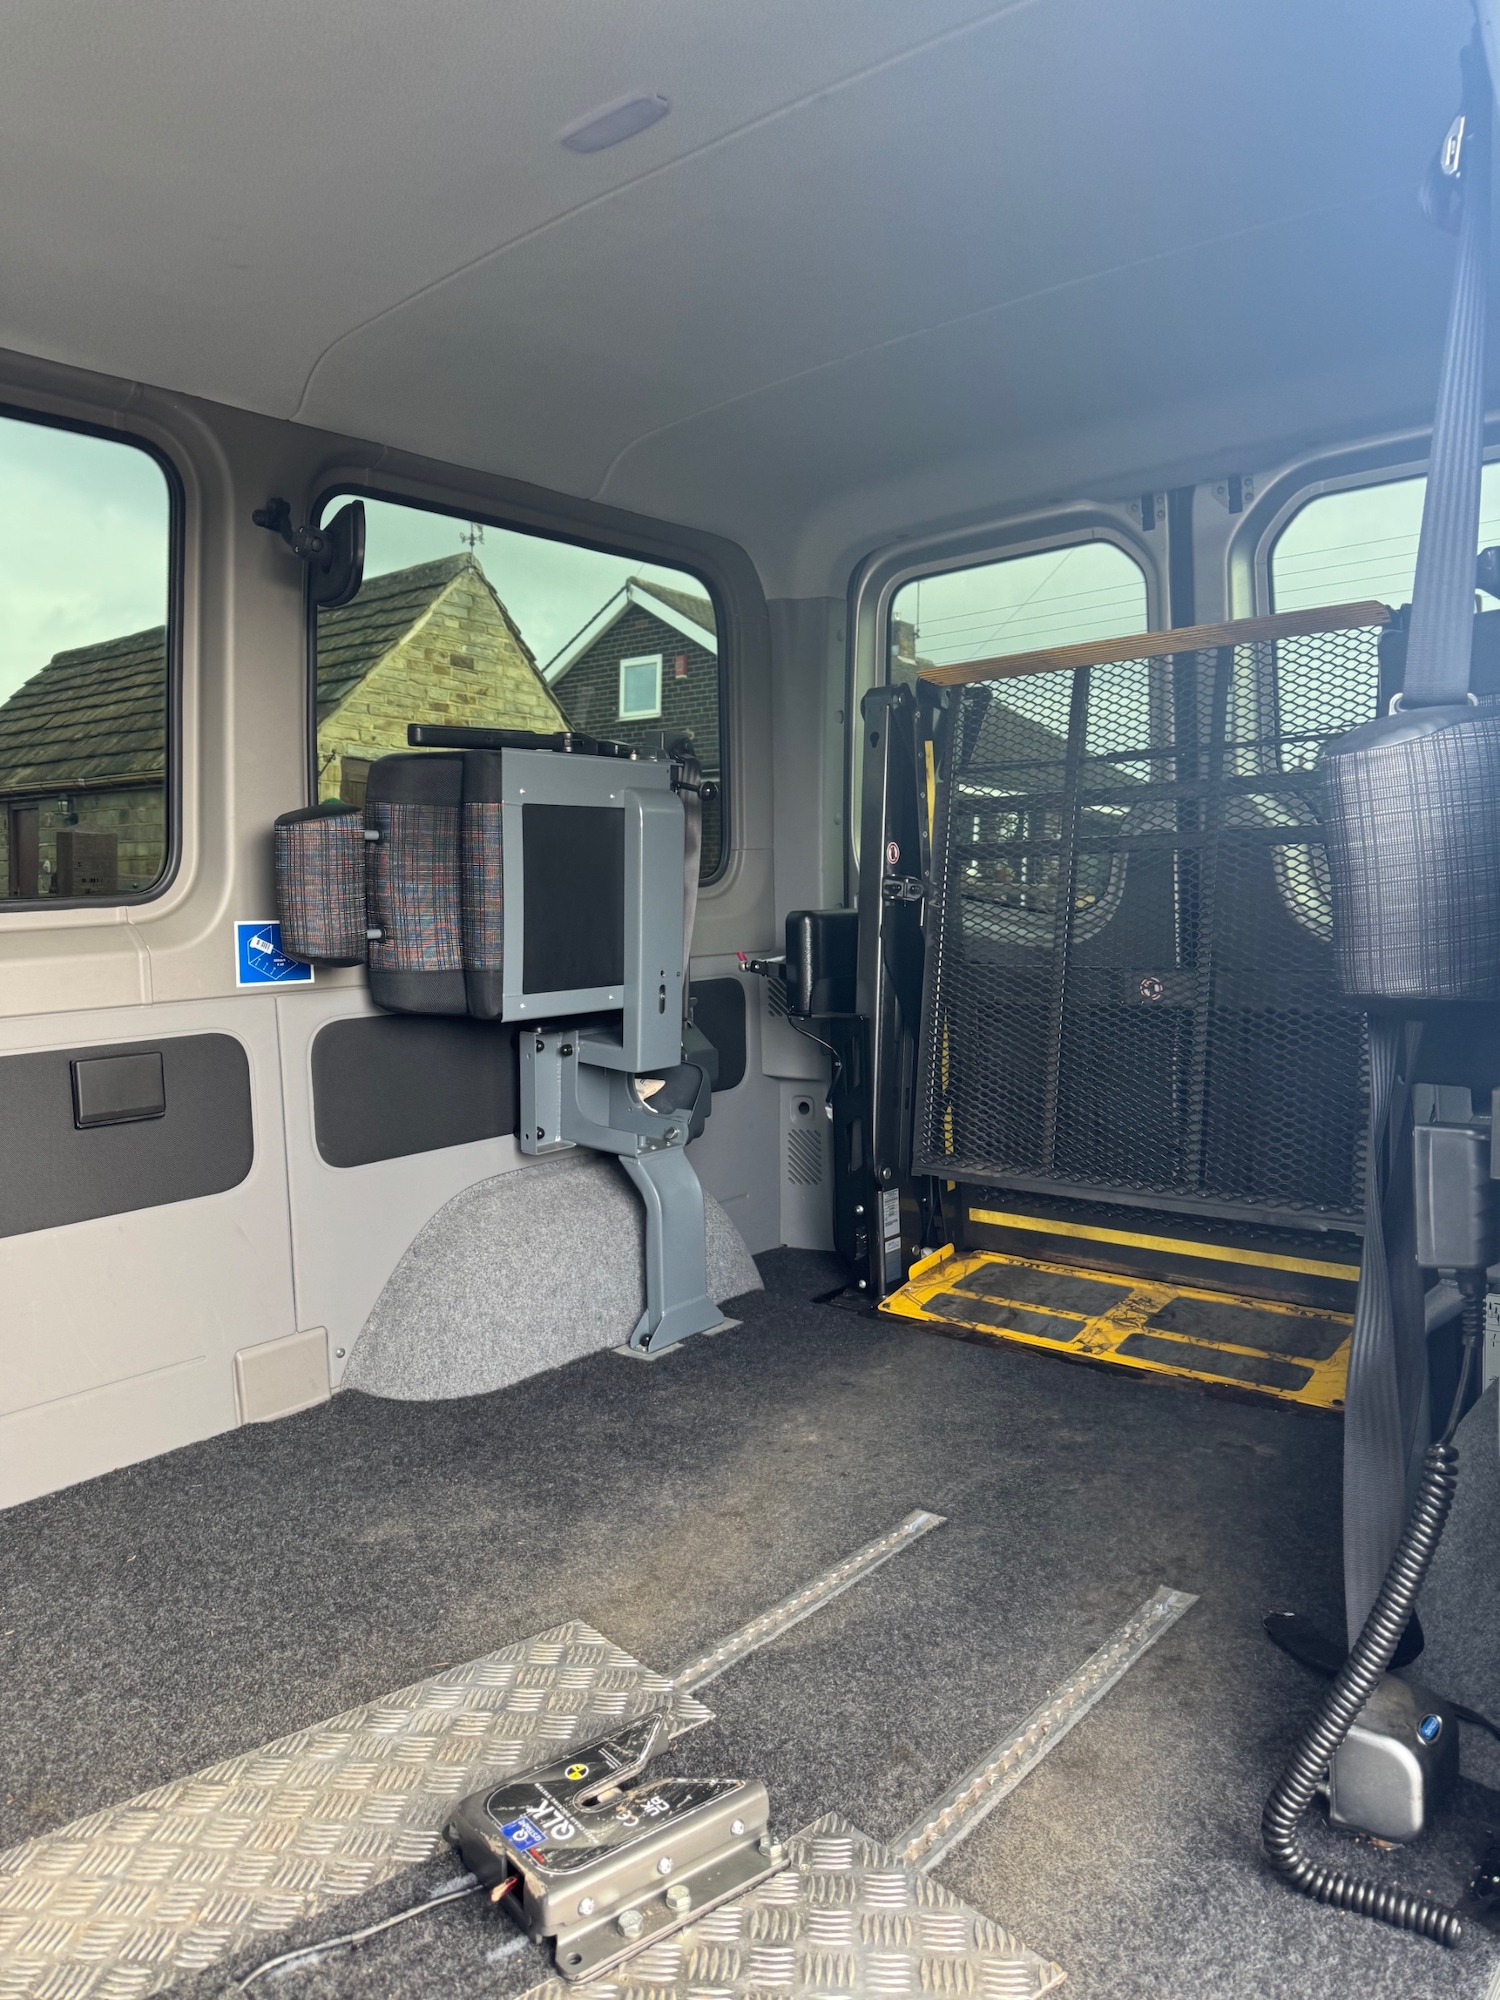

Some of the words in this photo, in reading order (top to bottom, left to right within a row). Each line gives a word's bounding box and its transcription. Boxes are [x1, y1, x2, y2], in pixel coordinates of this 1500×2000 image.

[534, 1782, 554, 1799] SYSTEM
[550, 1798, 572, 1817] DOCKING
[526, 1799, 576, 1840] QLK
[615, 1809, 640, 1827] CE
[569, 1816, 599, 1844] WHEELCHAIR
